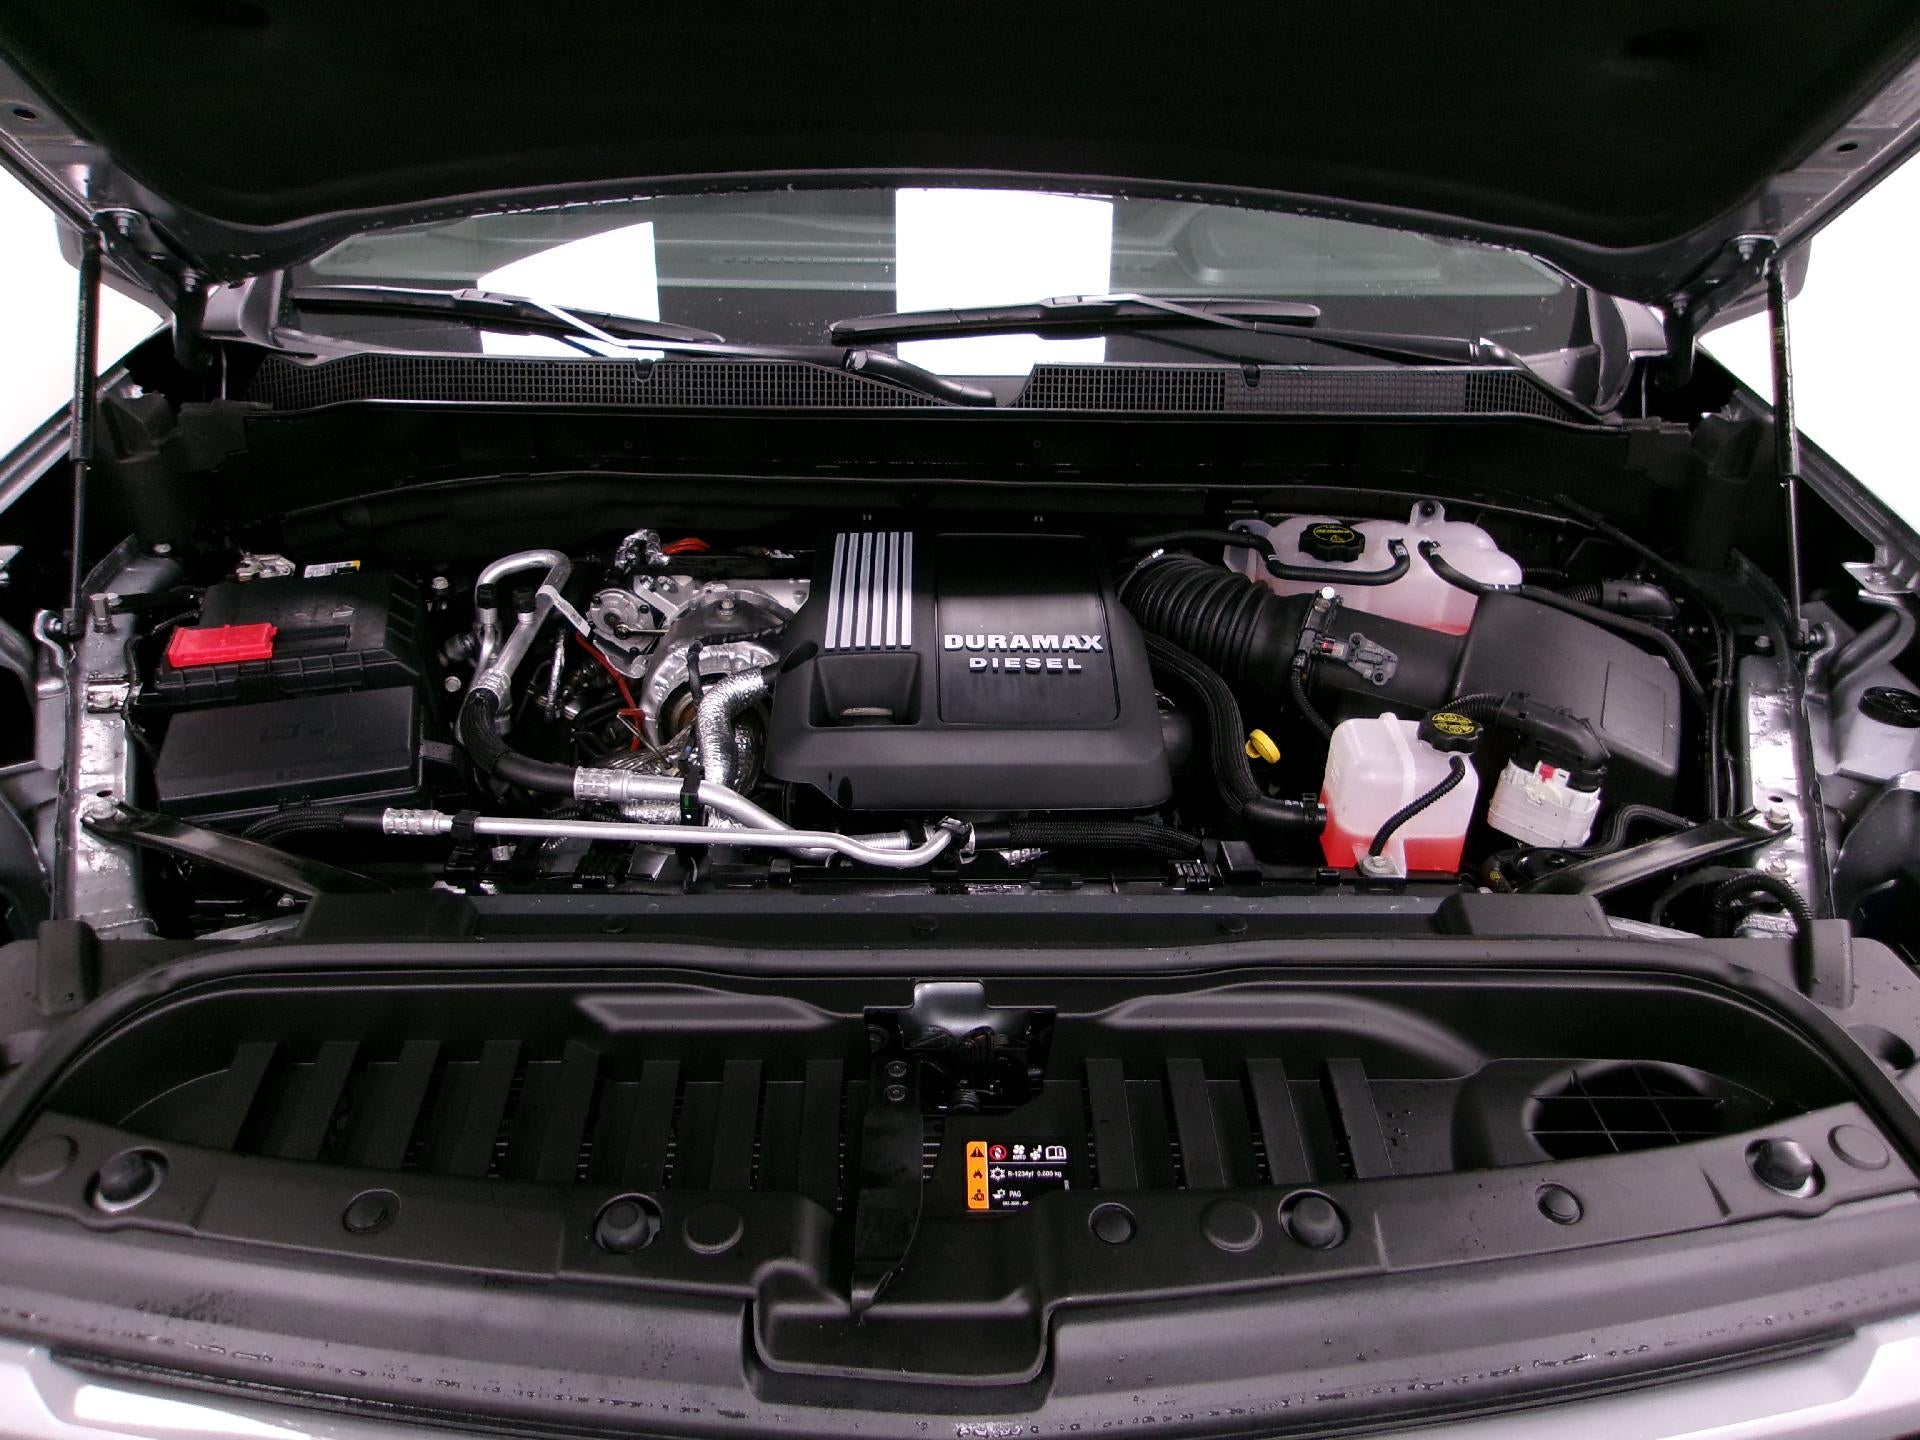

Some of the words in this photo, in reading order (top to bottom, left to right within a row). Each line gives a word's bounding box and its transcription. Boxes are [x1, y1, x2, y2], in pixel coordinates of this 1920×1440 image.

[944, 634, 1104, 652] DURAMAX
[969, 657, 1082, 673] DIESEL
[1054, 1170, 1062, 1178] kg
[1009, 1190, 1022, 1198] PAG
